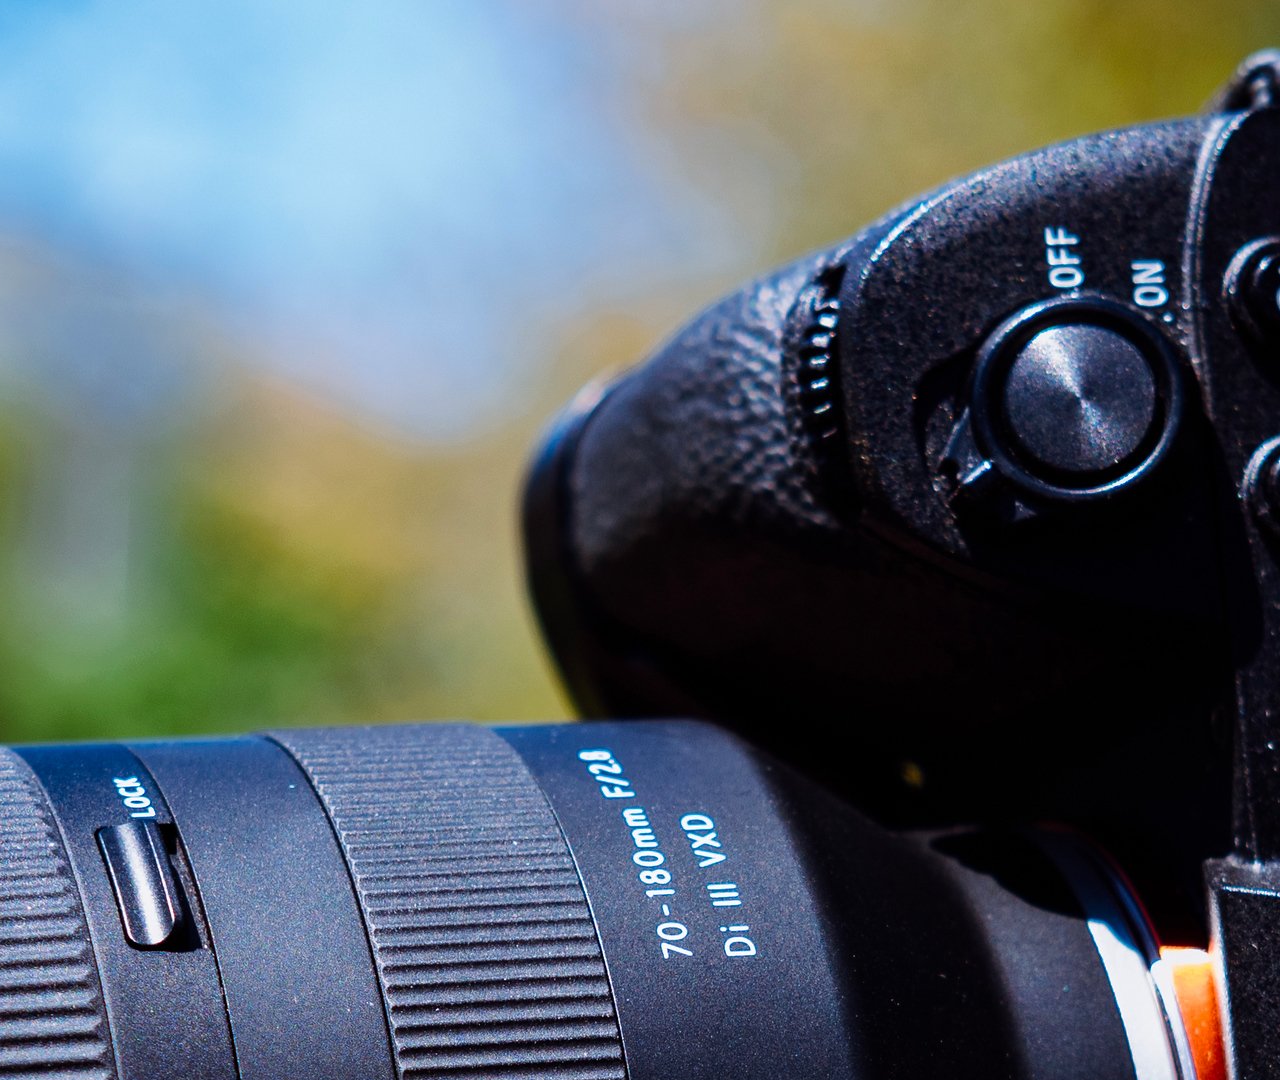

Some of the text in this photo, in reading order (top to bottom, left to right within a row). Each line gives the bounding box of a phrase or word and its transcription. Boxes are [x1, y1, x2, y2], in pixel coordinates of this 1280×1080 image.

[1044, 227, 1085, 293] OFF
[1131, 261, 1169, 307] ON
[112, 776, 157, 818] LOCK
[622, 807, 697, 960] 70-180mm
[680, 813, 757, 957] Di III VXD
